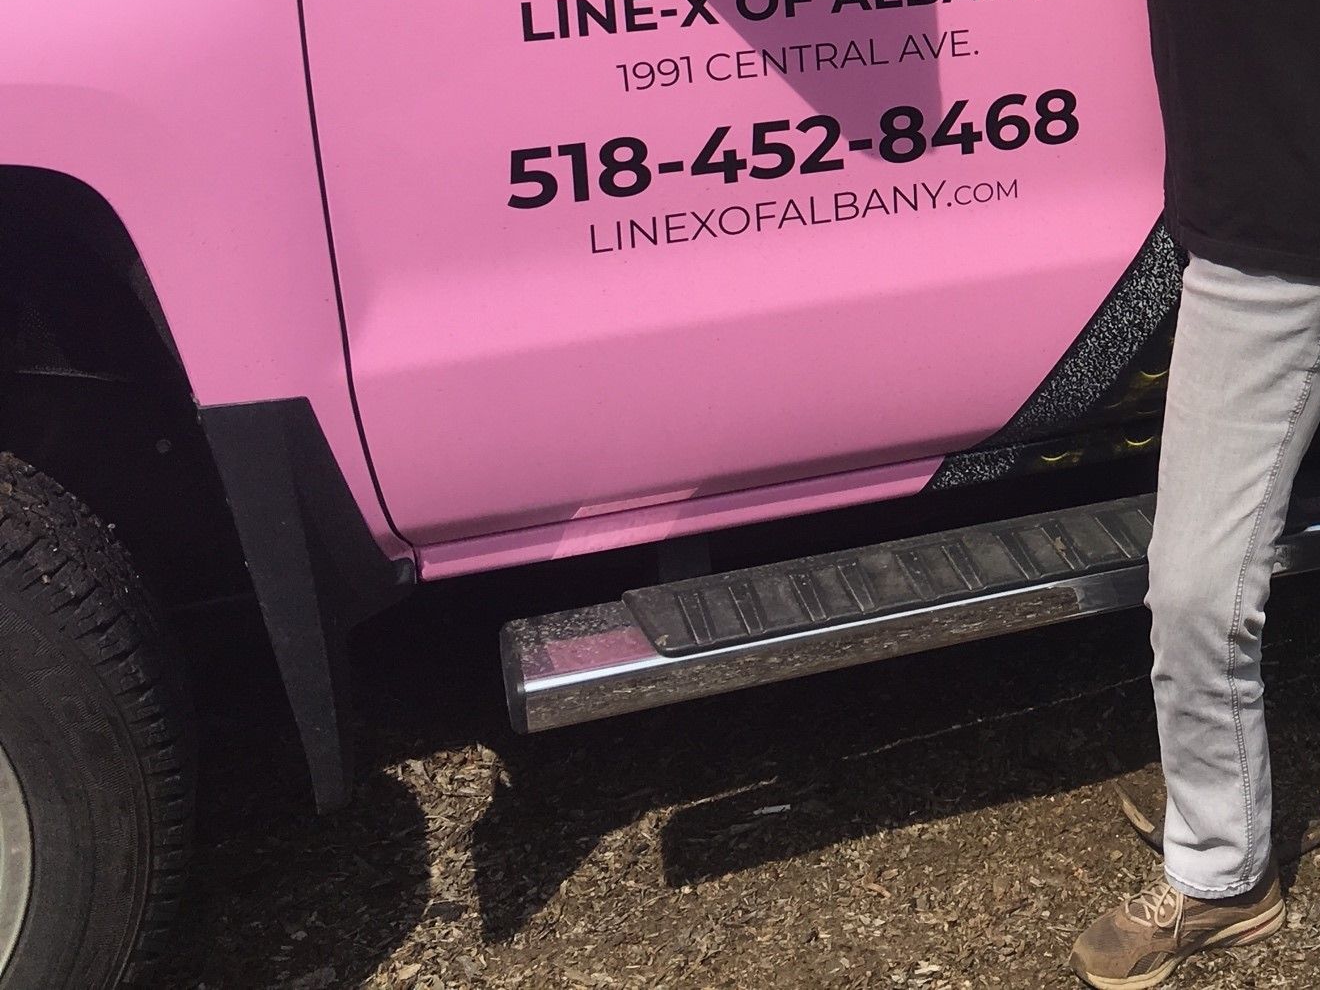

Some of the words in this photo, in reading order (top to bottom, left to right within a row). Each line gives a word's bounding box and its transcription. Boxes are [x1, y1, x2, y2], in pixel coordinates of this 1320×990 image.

[616, 56, 694, 92] 1991
[706, 38, 889, 82] CENTRAL
[898, 30, 980, 63] AVE.
[507, 89, 1080, 209] 518-452-8468
[589, 178, 1019, 254] LINEXOFALBANY.COM
